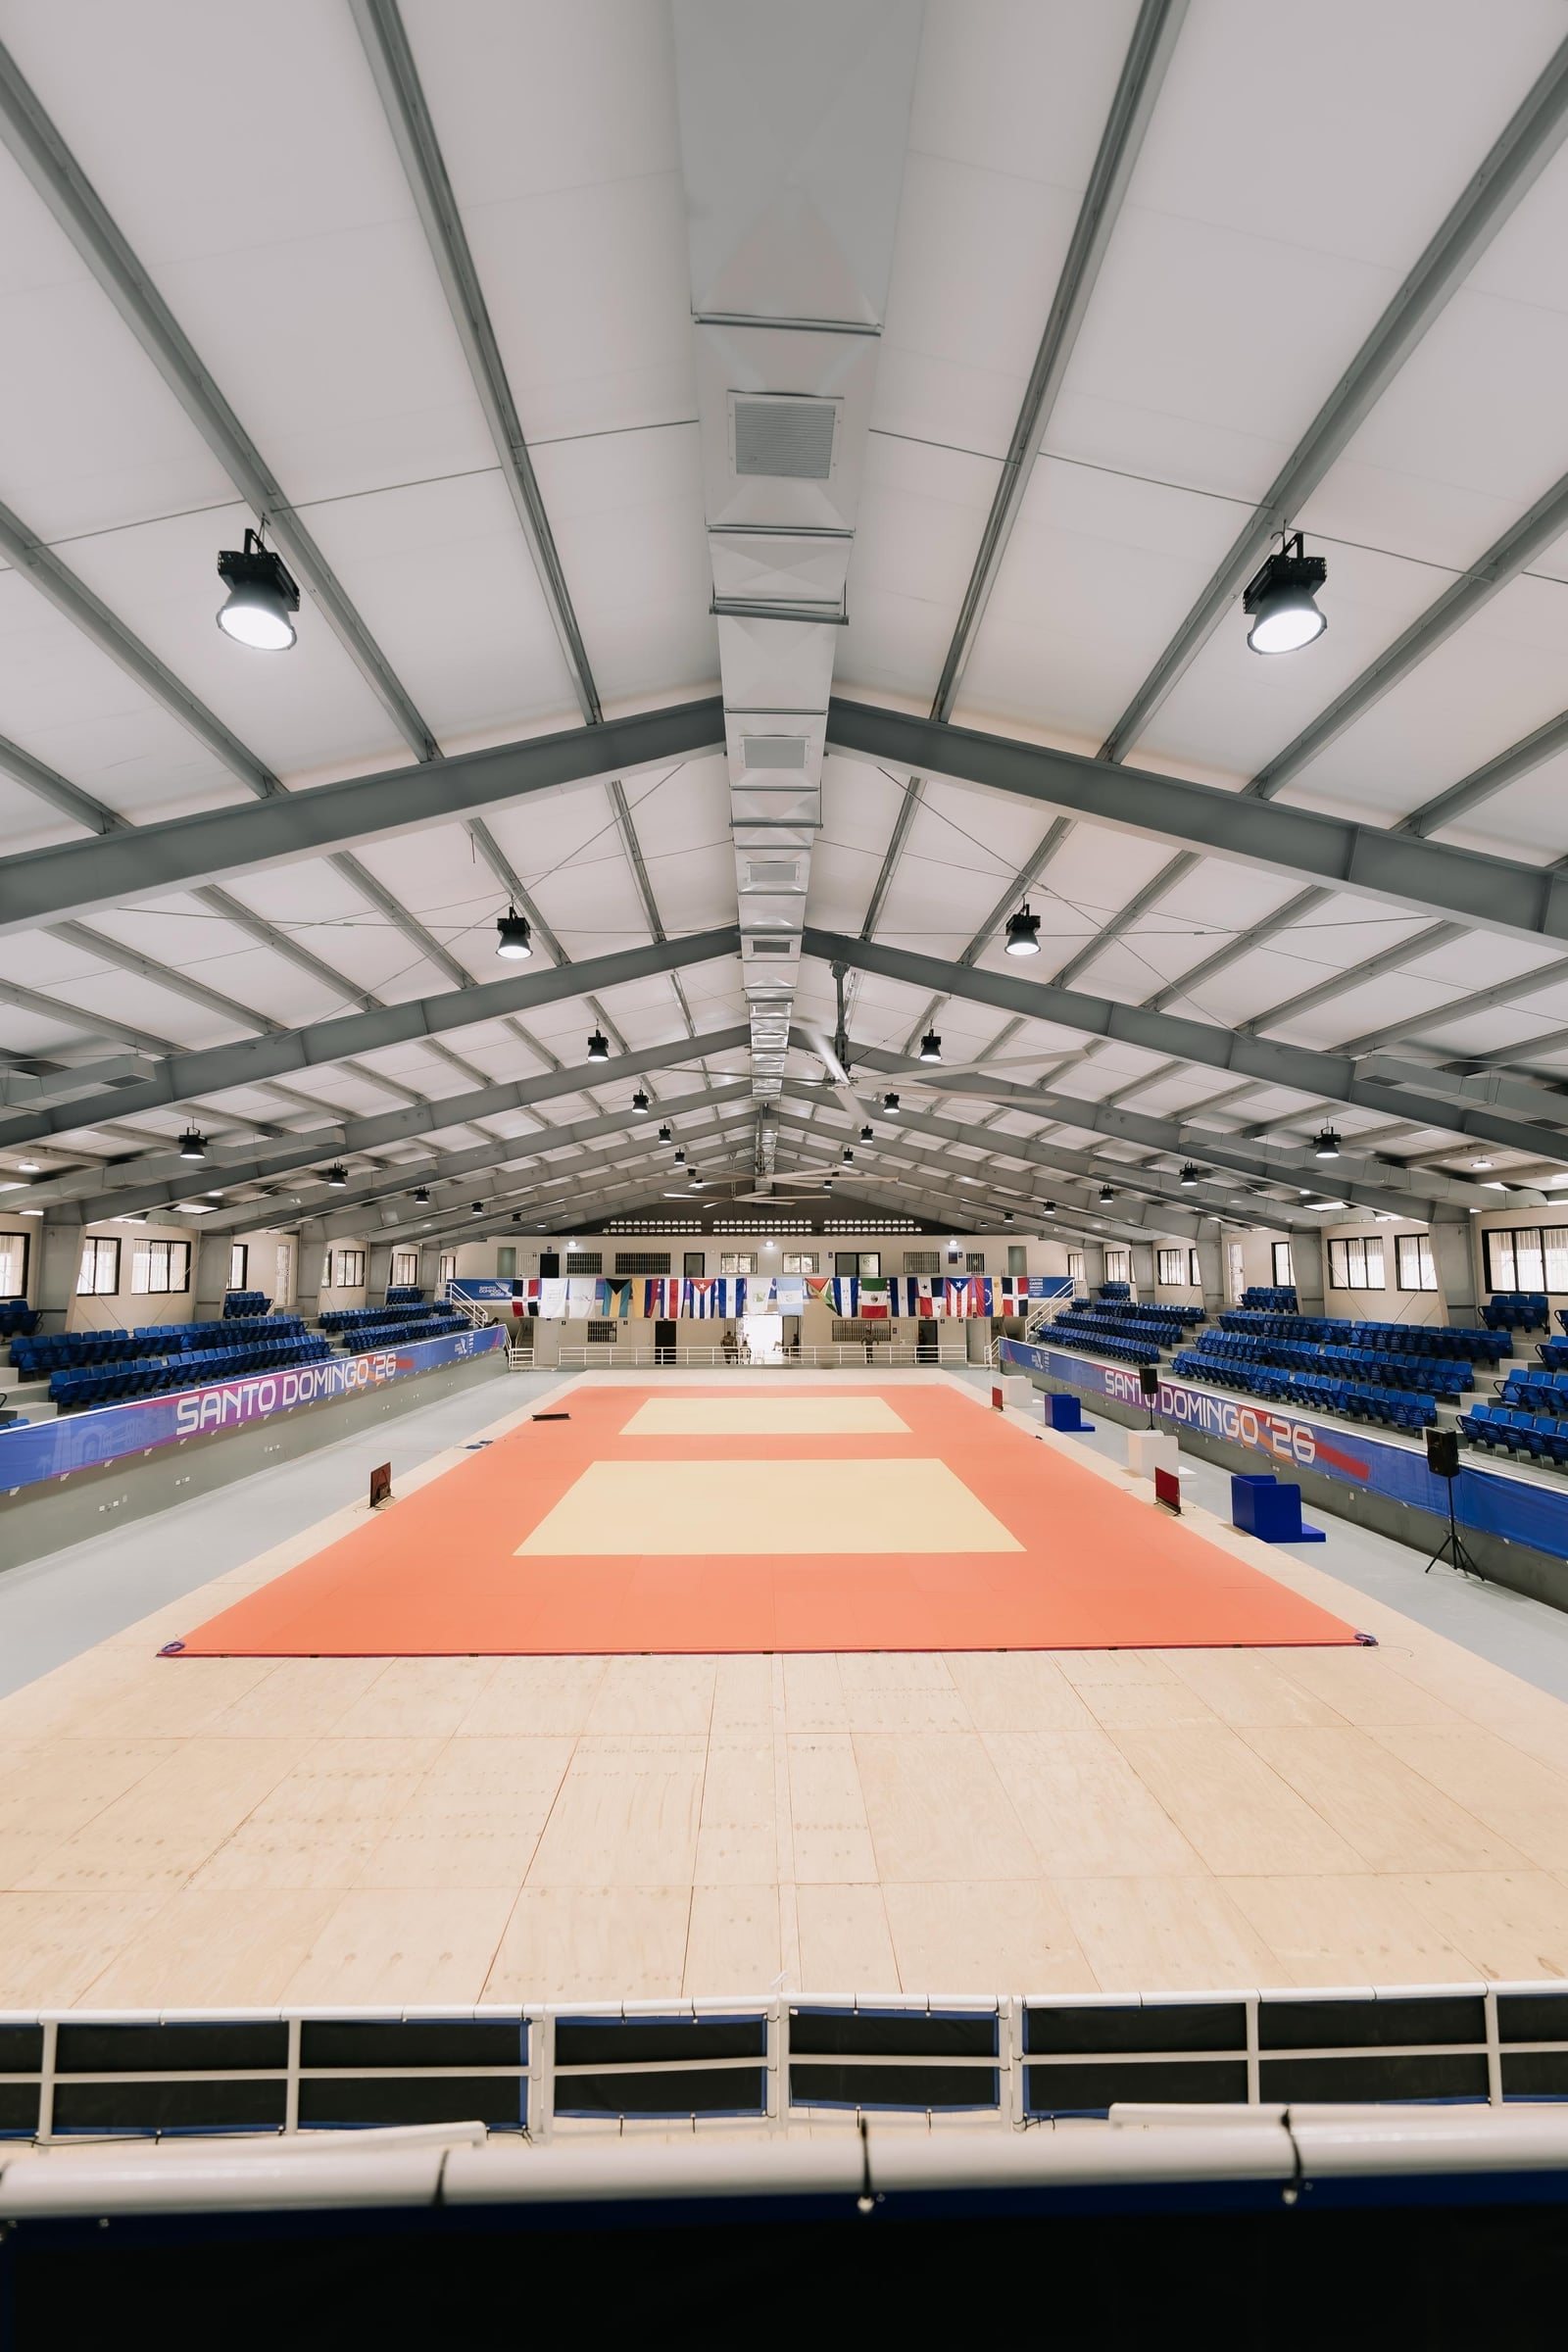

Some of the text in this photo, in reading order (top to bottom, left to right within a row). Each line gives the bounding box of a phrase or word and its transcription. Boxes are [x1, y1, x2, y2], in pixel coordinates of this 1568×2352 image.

[176, 1352, 396, 1435] SANTO DOMINGO '26
[1161, 1386, 1258, 1445] DOMINGO
[1266, 1416, 1315, 1464] '26
